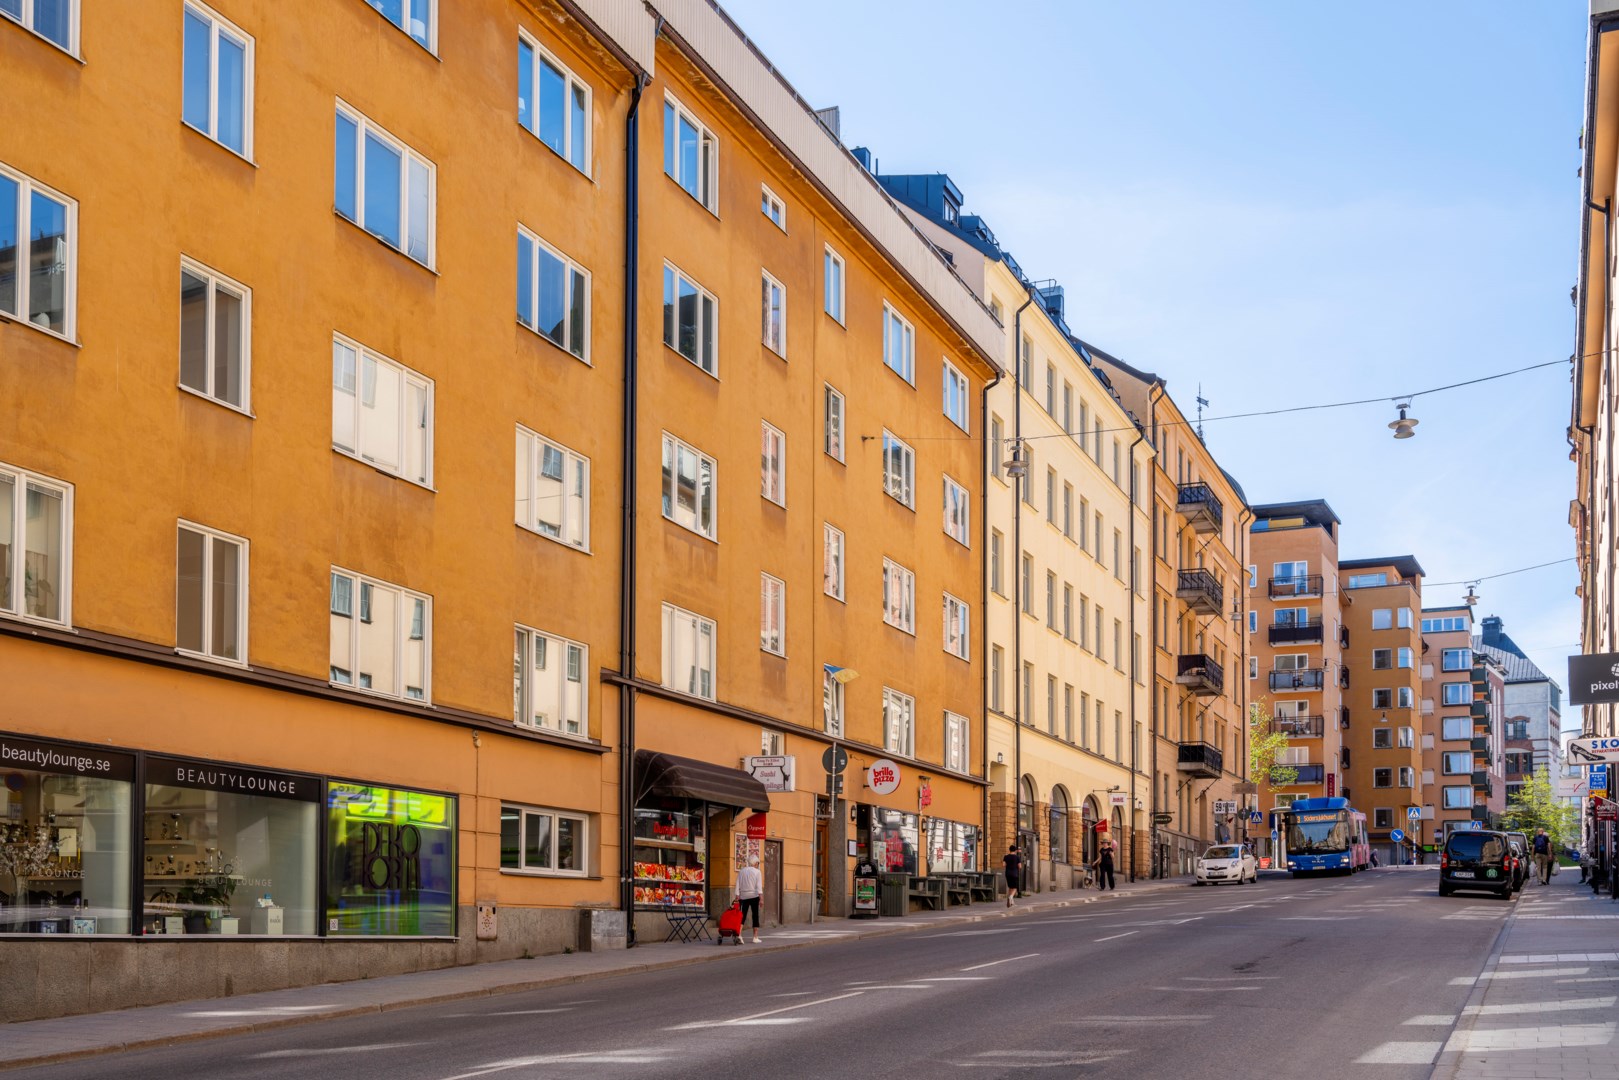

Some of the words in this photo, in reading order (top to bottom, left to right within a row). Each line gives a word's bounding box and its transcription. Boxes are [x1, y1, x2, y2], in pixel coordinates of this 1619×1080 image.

[1591, 680, 1619, 693] pixel
[2, 744, 110, 771] beautylounge.se
[873, 767, 893, 778] brillo
[177, 768, 295, 794] BEAUTYLOUNGE
[873, 775, 895, 787] pizza
